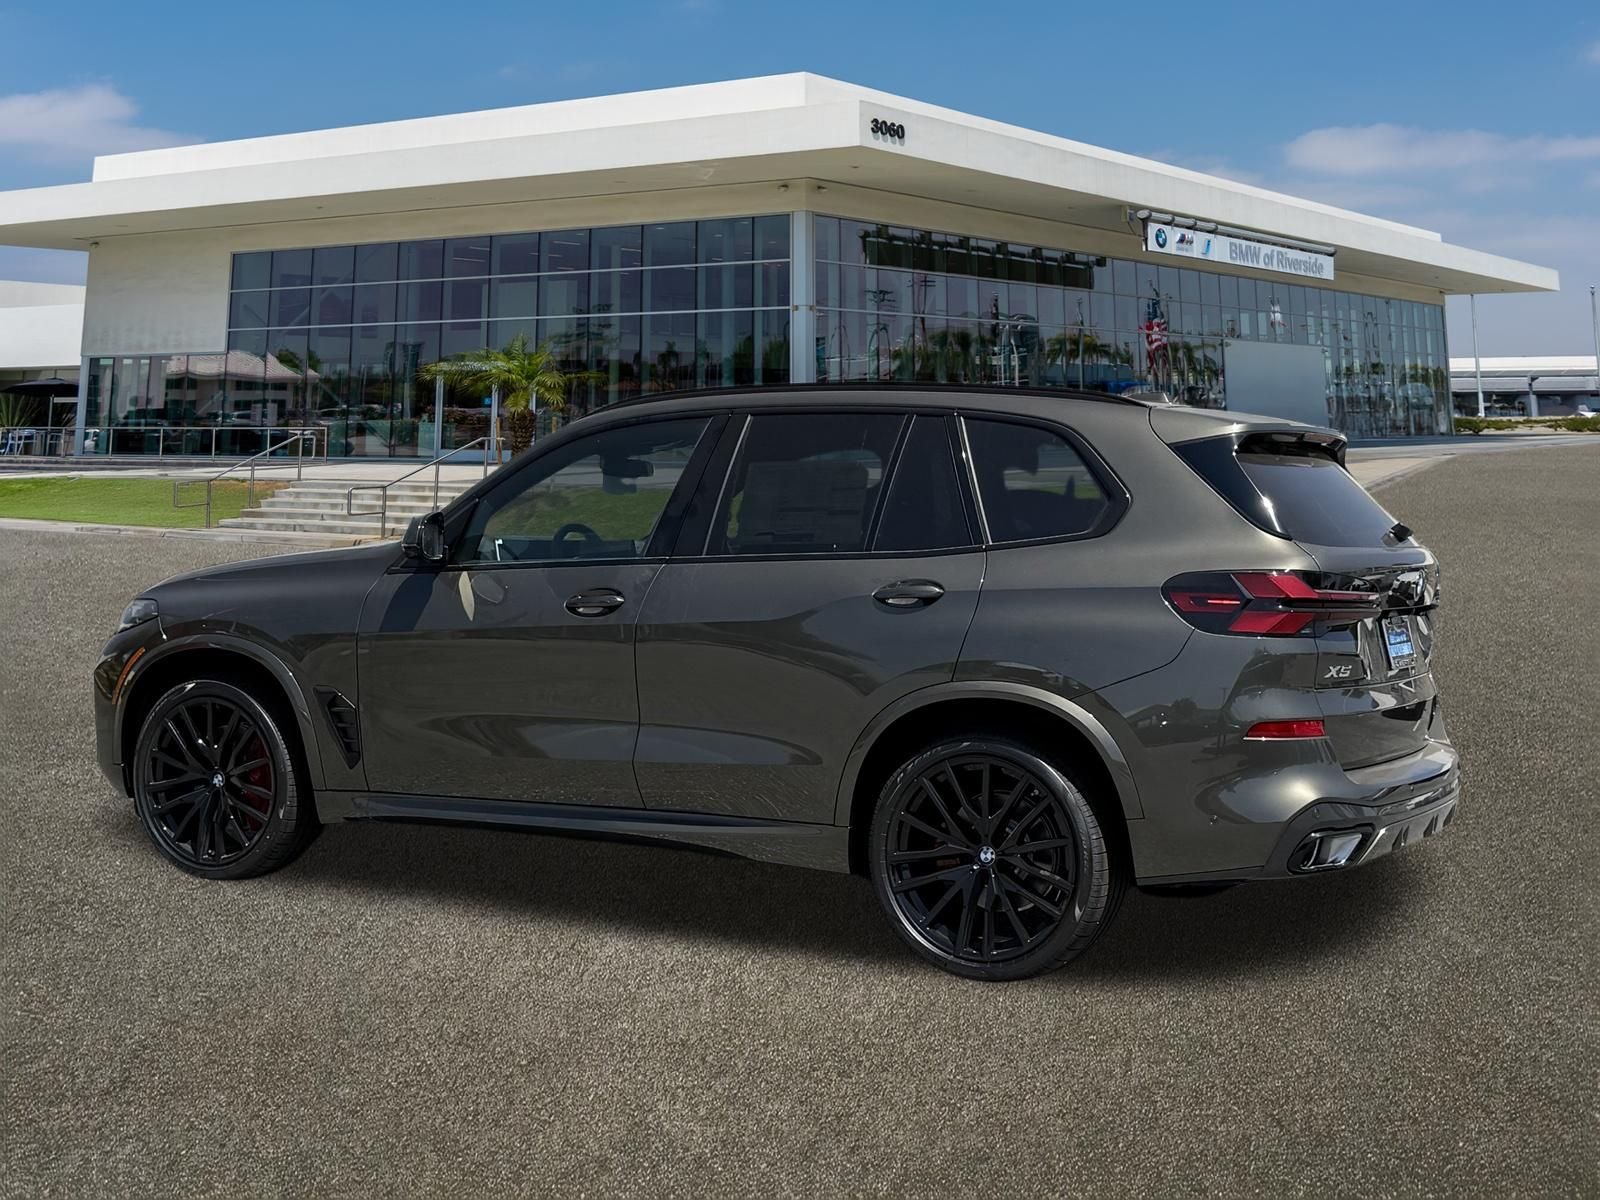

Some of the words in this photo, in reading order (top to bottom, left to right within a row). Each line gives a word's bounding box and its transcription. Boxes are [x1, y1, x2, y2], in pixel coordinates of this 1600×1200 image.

[870, 118, 905, 139] 3060
[1229, 241, 1261, 265] BMW
[1263, 249, 1275, 267] of
[1276, 250, 1324, 275] Riverside
[1323, 665, 1352, 678] X5
